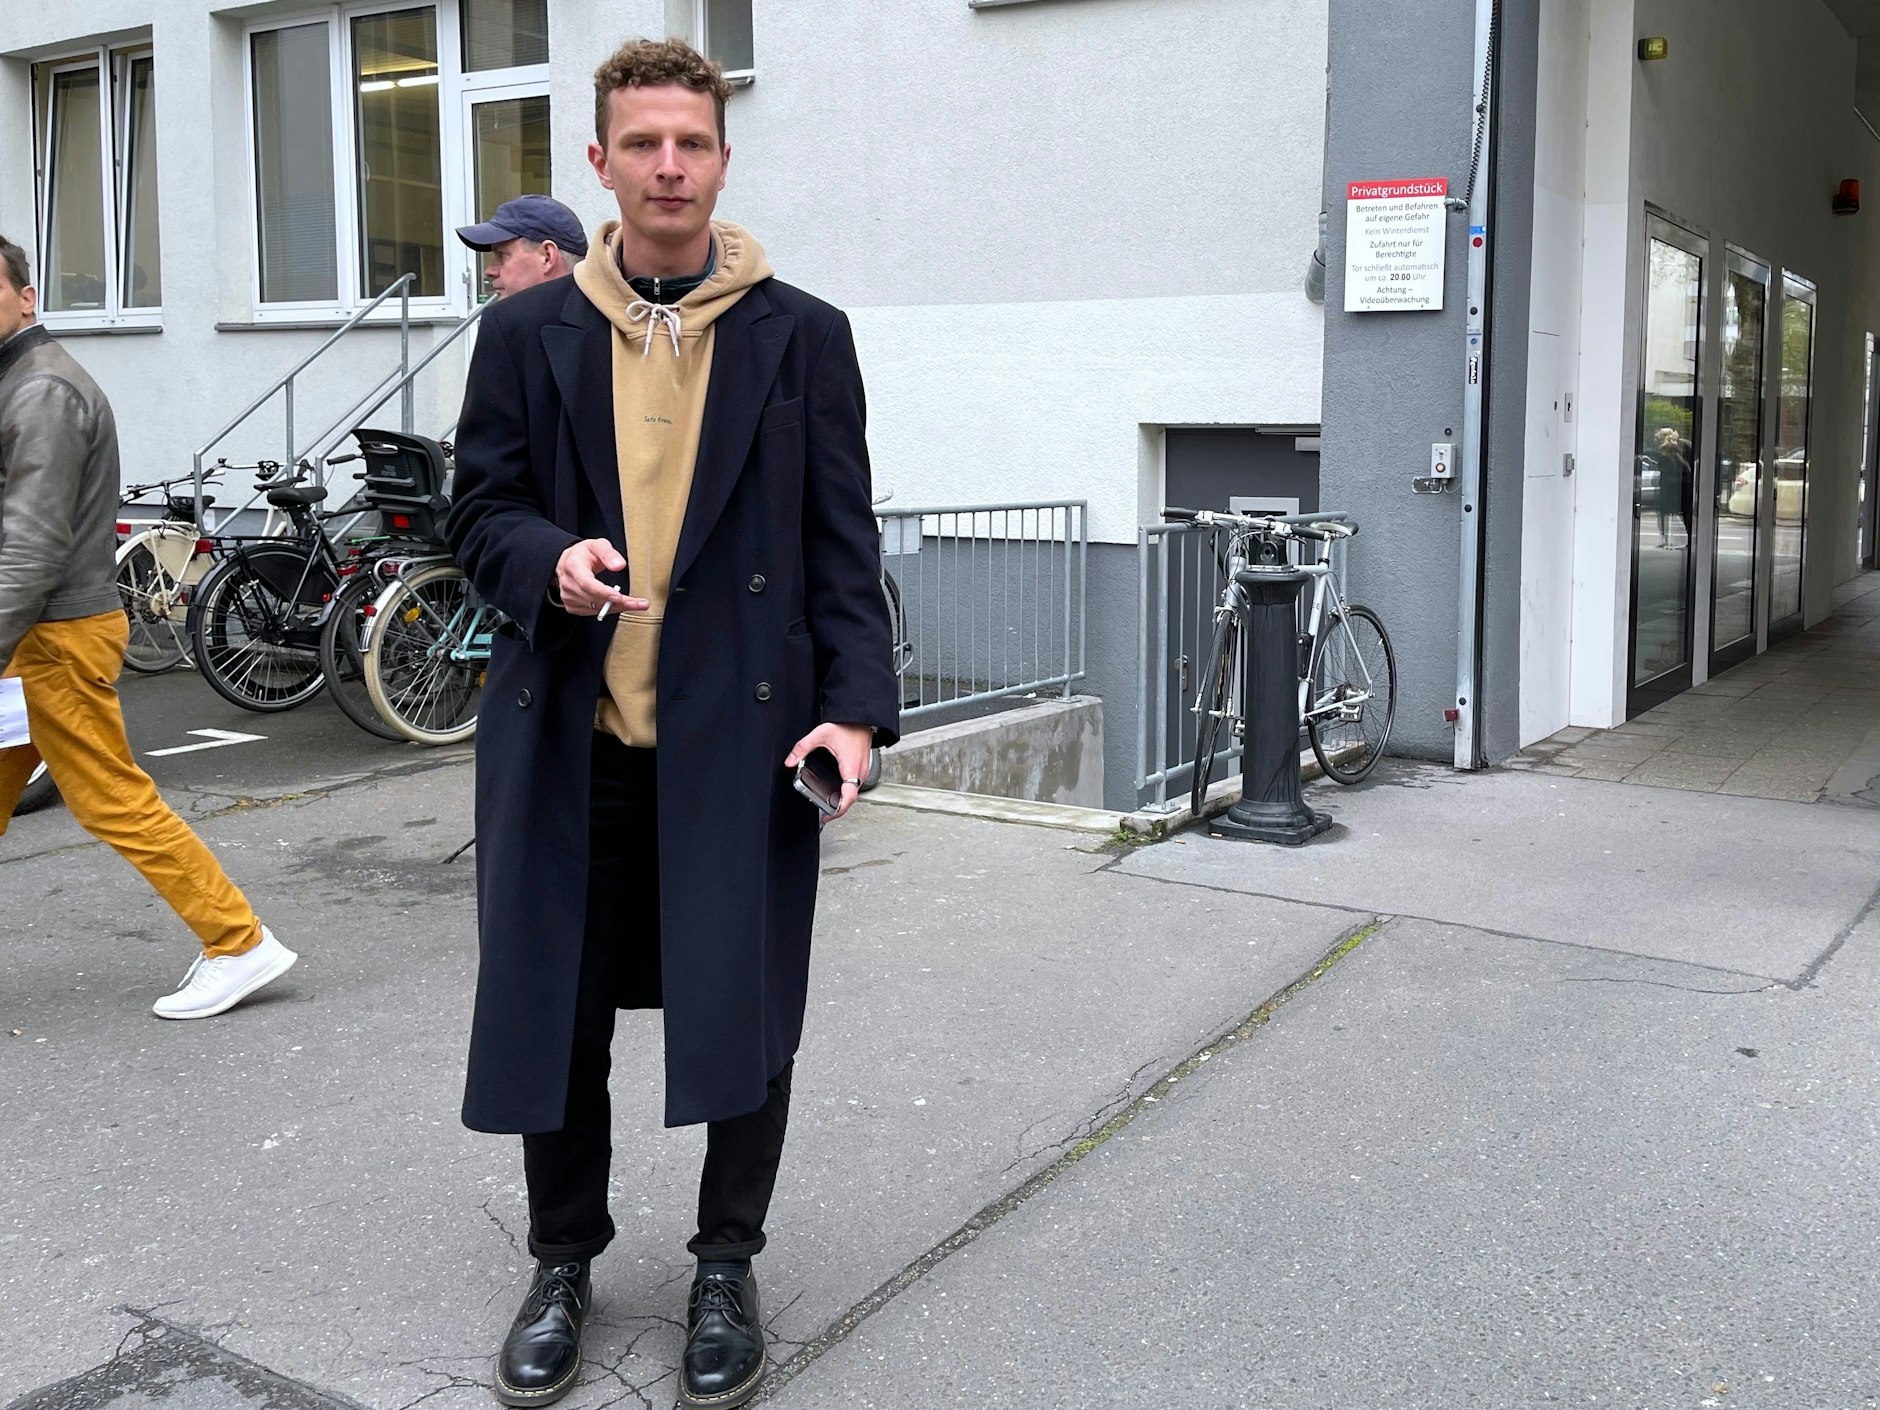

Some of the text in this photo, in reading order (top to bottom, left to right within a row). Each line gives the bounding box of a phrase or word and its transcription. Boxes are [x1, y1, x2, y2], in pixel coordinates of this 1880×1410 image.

[1351, 182, 1443, 198] Privatgrundstück
[1356, 203, 1439, 213] Betreten und Befahren
[1378, 215, 1403, 223] eigene
[1404, 213, 1430, 221] Gefahr
[1365, 226, 1430, 236] Kein Winterdienst
[1369, 241, 1396, 249] Zufahrt
[1412, 239, 1424, 247] für
[1375, 250, 1417, 259] Berechtigte
[1352, 262, 1439, 272] Tor schließt automatisch
[1390, 273, 1411, 281] 20.00
[1376, 286, 1407, 295] Achtung
[1360, 296, 1430, 304] Videoüberwachung
